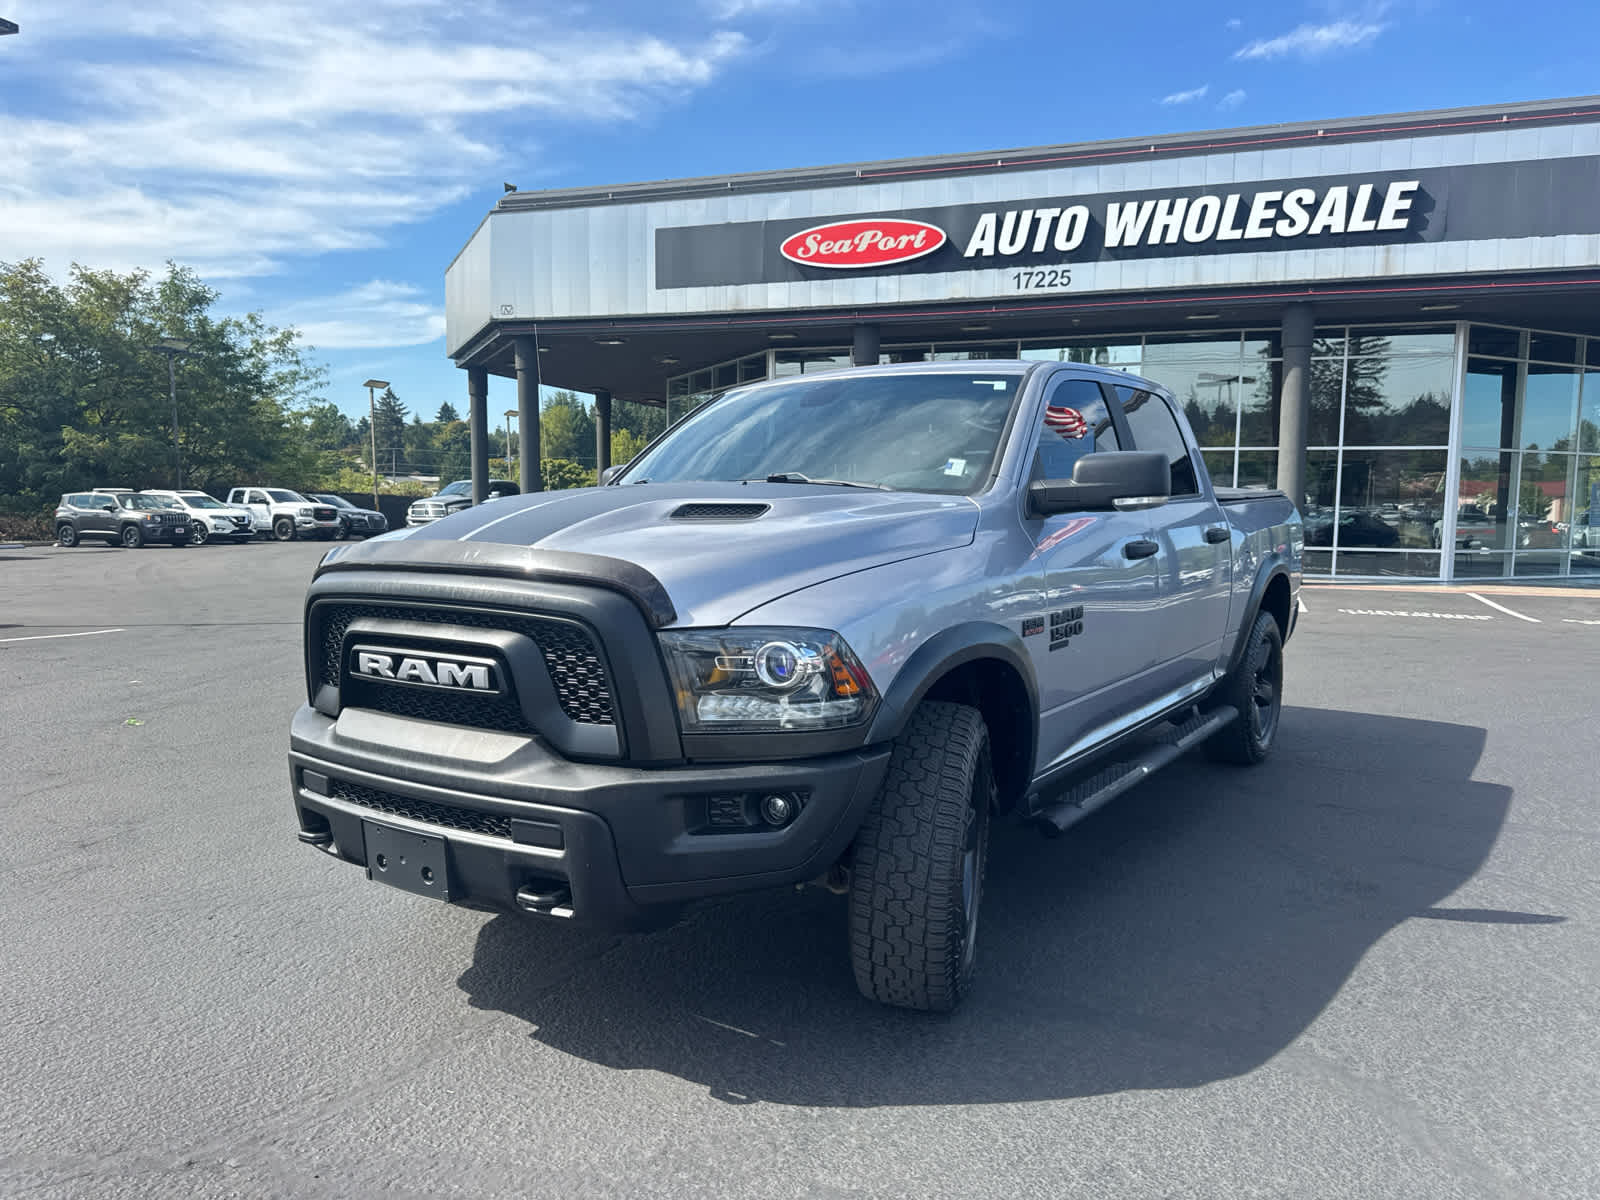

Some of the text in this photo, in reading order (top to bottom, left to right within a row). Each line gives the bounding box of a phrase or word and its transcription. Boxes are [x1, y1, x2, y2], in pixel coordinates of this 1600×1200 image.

[797, 180, 1420, 258] SeaPort AUTO WHOLESALE
[1012, 269, 1072, 290] 17225
[359, 652, 490, 690] RAM
